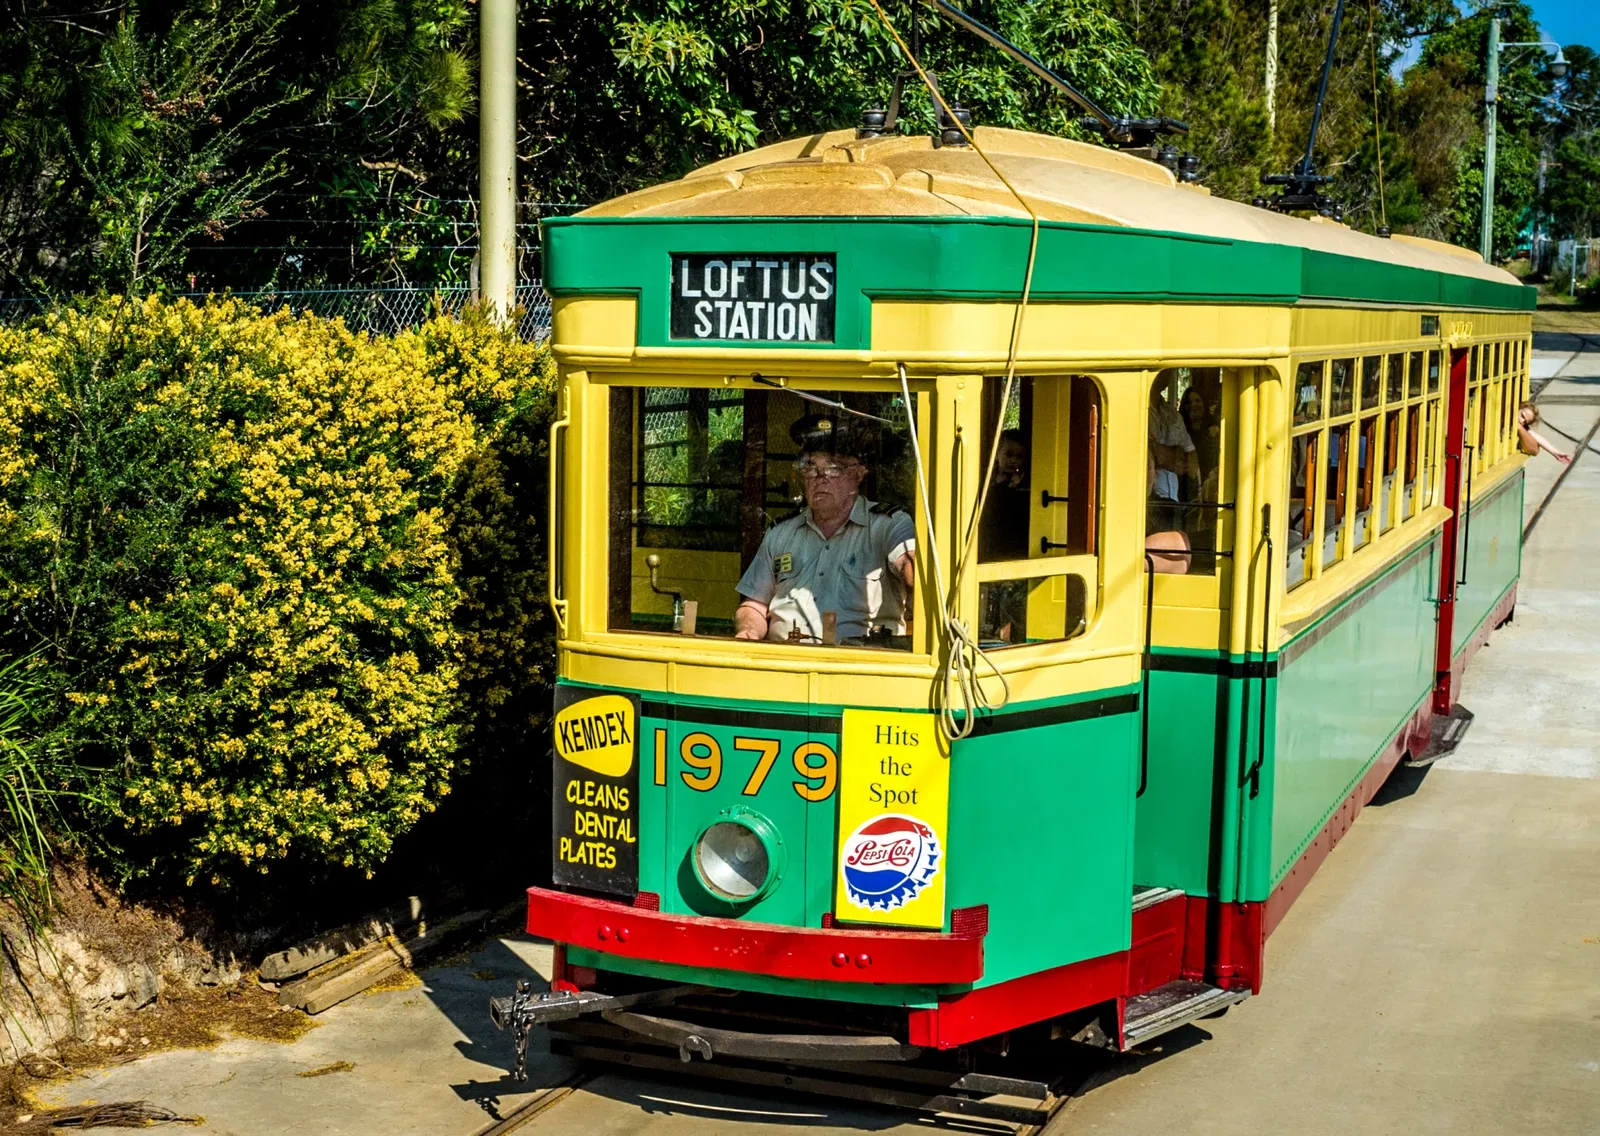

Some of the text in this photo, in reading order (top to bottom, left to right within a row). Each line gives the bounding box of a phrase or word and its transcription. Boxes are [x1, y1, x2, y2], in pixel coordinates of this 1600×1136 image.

[681, 259, 834, 300] LOFTUS
[694, 300, 818, 341] STATION
[558, 710, 631, 755] KEMDEX
[875, 724, 920, 747] Hits
[653, 727, 838, 802] 1979
[880, 756, 912, 777] the
[565, 780, 630, 812] CLEANS
[869, 782, 919, 808] Spot
[574, 810, 636, 843] DENTAL
[559, 836, 617, 869] PLATES
